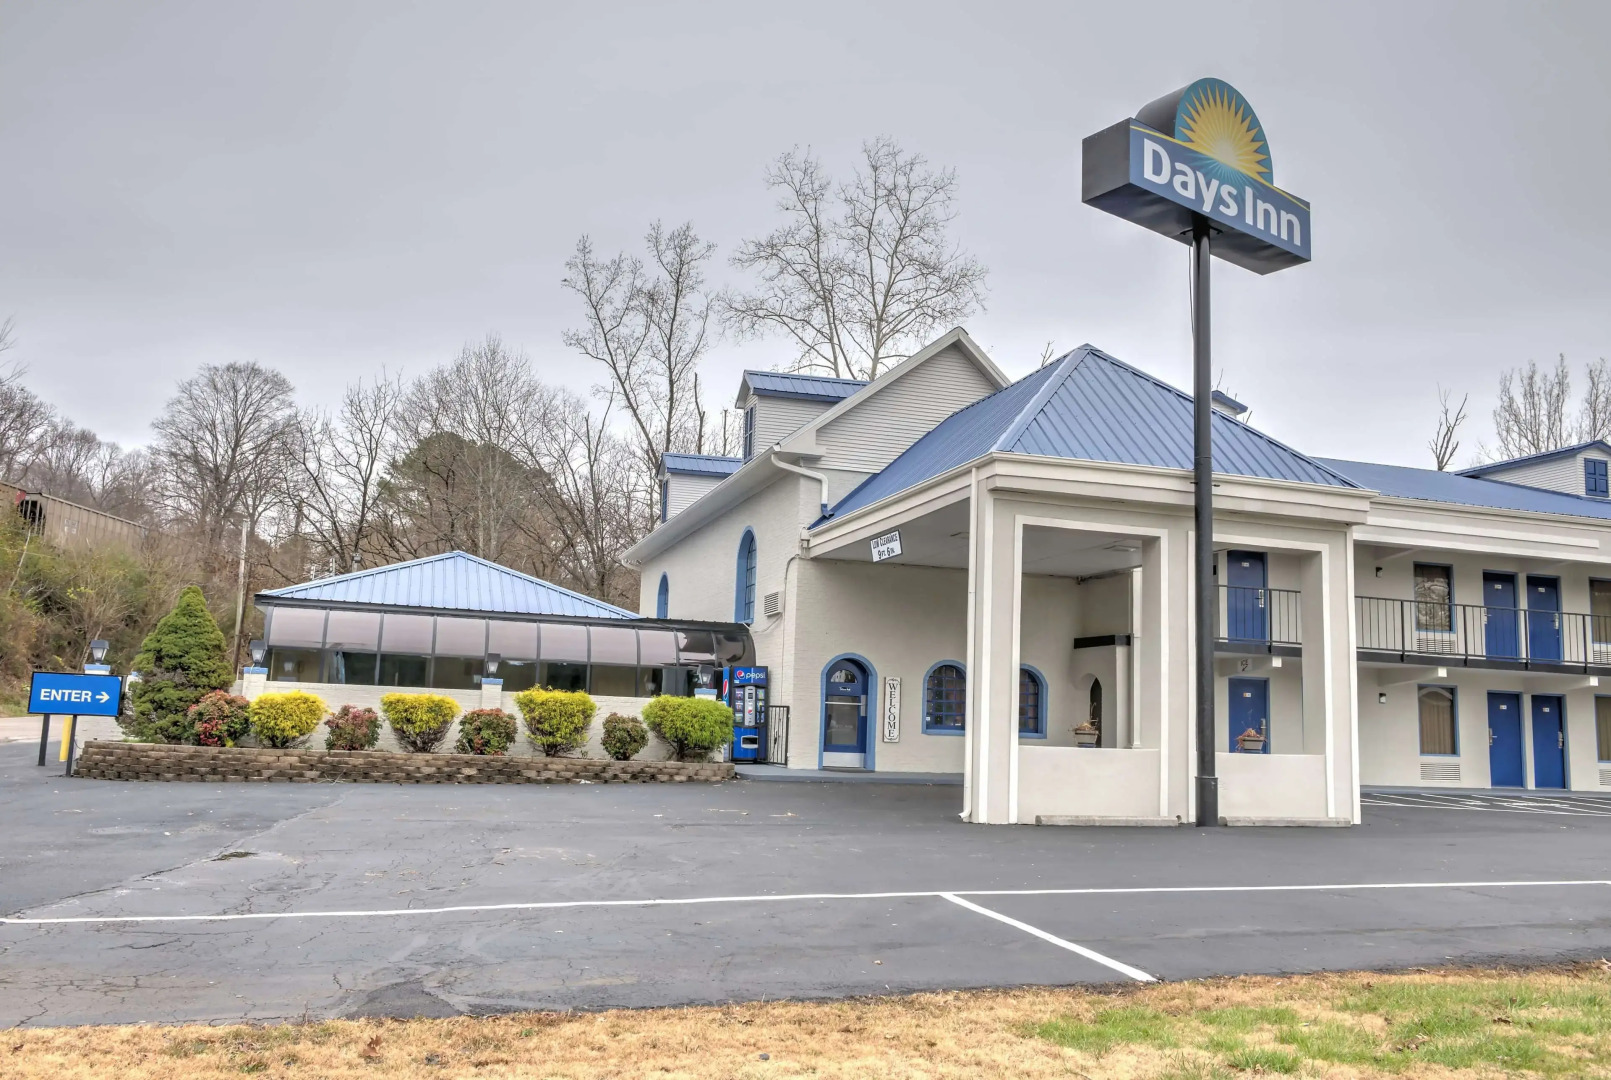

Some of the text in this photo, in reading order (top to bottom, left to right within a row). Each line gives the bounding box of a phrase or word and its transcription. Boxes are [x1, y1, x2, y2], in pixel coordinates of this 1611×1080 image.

[1144, 138, 1301, 247] Days Inn
[745, 672, 766, 680] pepsi
[40, 688, 92, 702] ENTER
[888, 683, 898, 737] WELCOME
